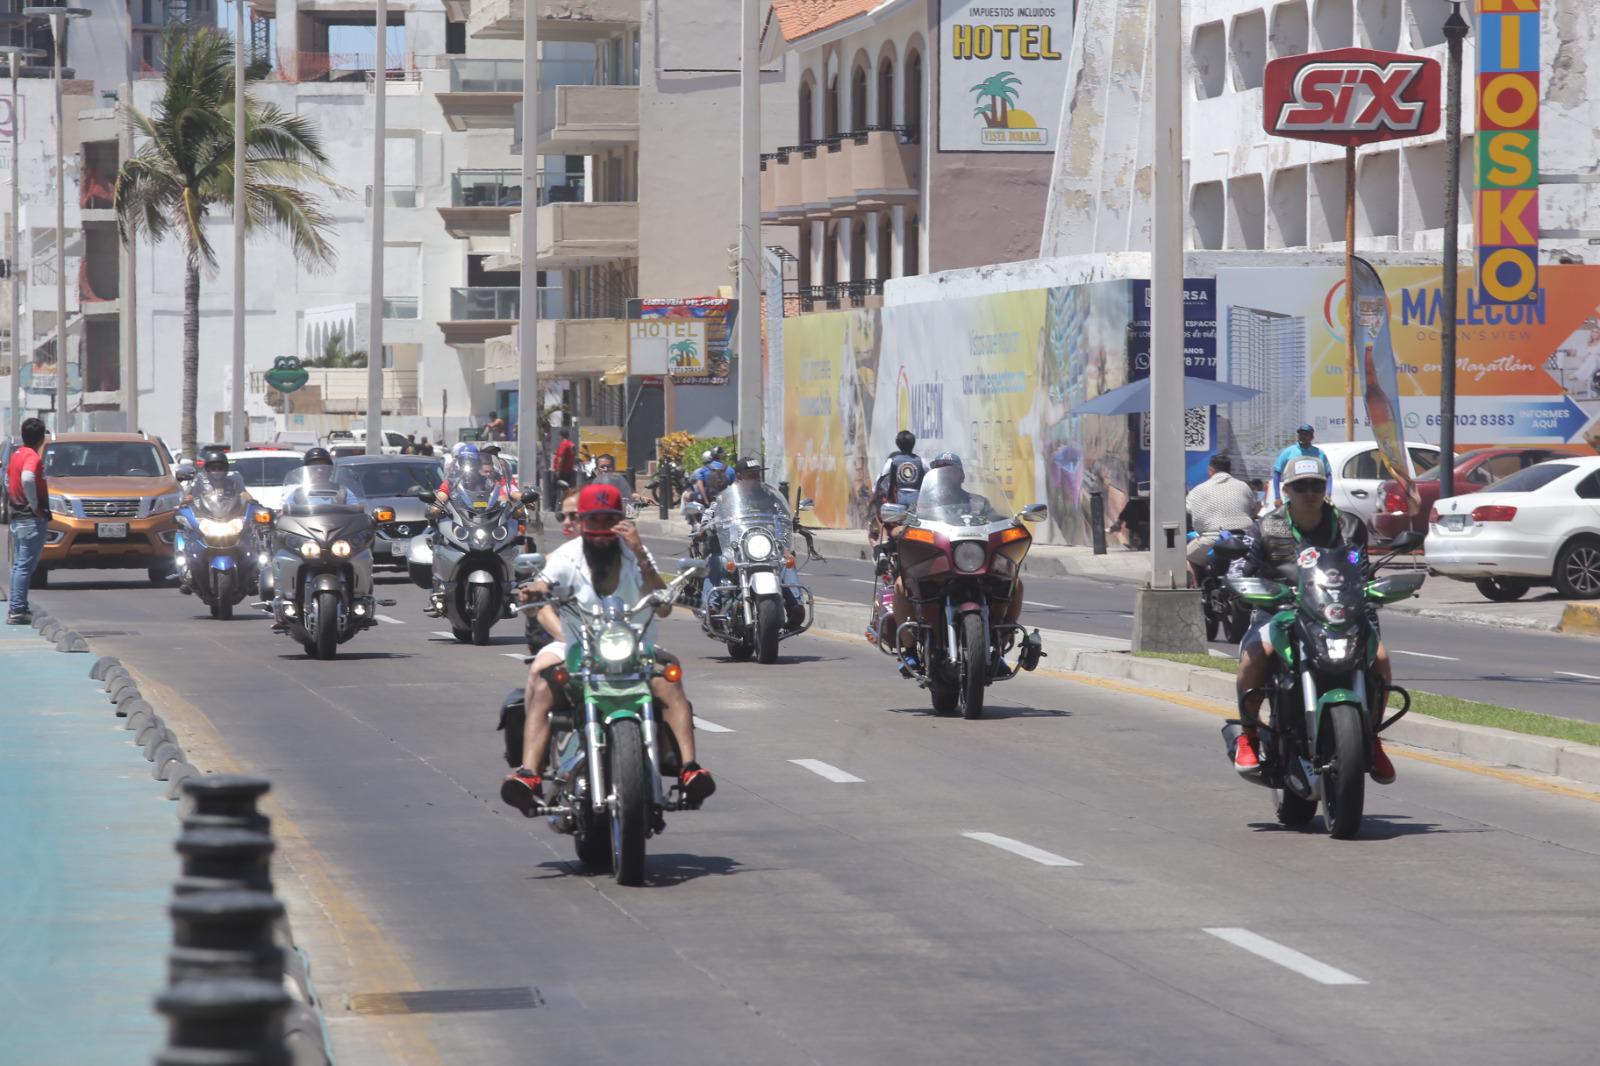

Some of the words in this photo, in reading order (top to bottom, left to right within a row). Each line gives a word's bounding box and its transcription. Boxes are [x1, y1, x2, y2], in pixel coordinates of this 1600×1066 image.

[969, 7, 1014, 18] IMPUESTOS
[1017, 7, 1056, 18] INCLUIDOS
[952, 24, 1062, 60] HOTEL
[984, 130, 1006, 142] VISTA
[1008, 130, 1042, 142] DORADA
[1481, 0, 1538, 302] IOSKO
[1183, 290, 1208, 301] RSA
[636, 321, 699, 337] HOTEL
[1491, 331, 1533, 341] VIEW
[1194, 356, 1207, 366] 77
[1456, 354, 1536, 382] Mazatlán
[1519, 409, 1571, 419] INFORMES
[1425, 414, 1442, 426] 66
[1480, 414, 1514, 426] 8383
[1531, 418, 1558, 429] AQUÍ
